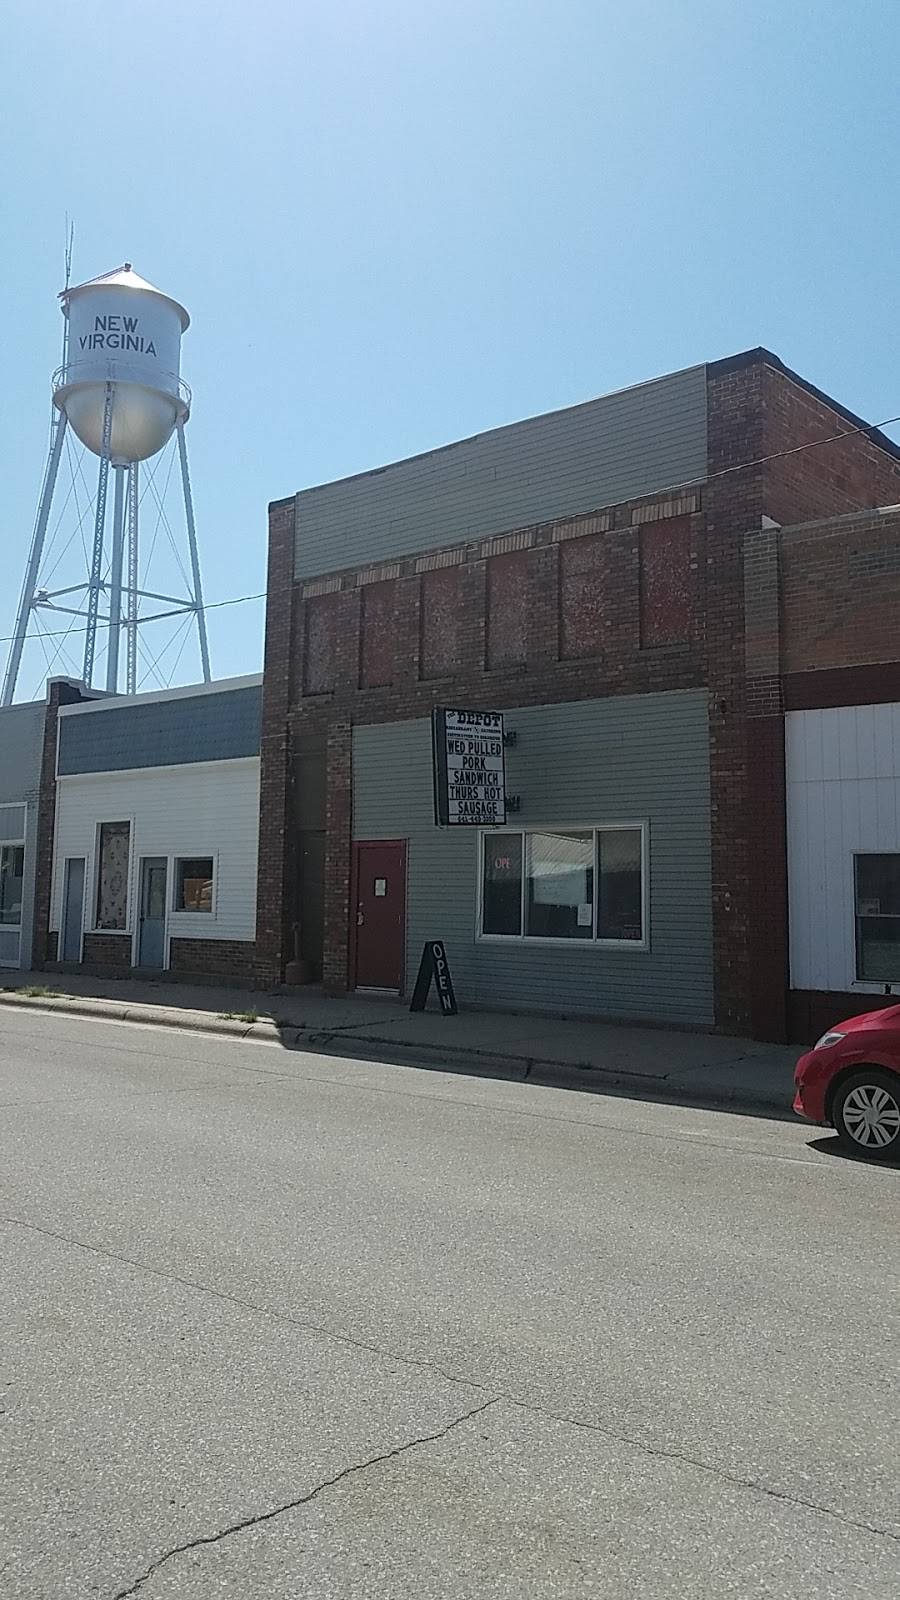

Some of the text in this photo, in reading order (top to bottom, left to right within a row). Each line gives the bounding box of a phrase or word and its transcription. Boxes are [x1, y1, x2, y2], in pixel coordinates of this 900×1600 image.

[94, 315, 139, 333] NEW
[79, 333, 157, 357] VIRGINIA
[457, 711, 501, 727] DEPOT
[448, 739, 502, 755] WED PULLED
[462, 756, 486, 770] PORK
[454, 770, 499, 786] SANDWICH
[450, 785, 501, 800] THURS HOT
[458, 801, 498, 814] SAUSAGE
[432, 943, 452, 1009] OPEN
